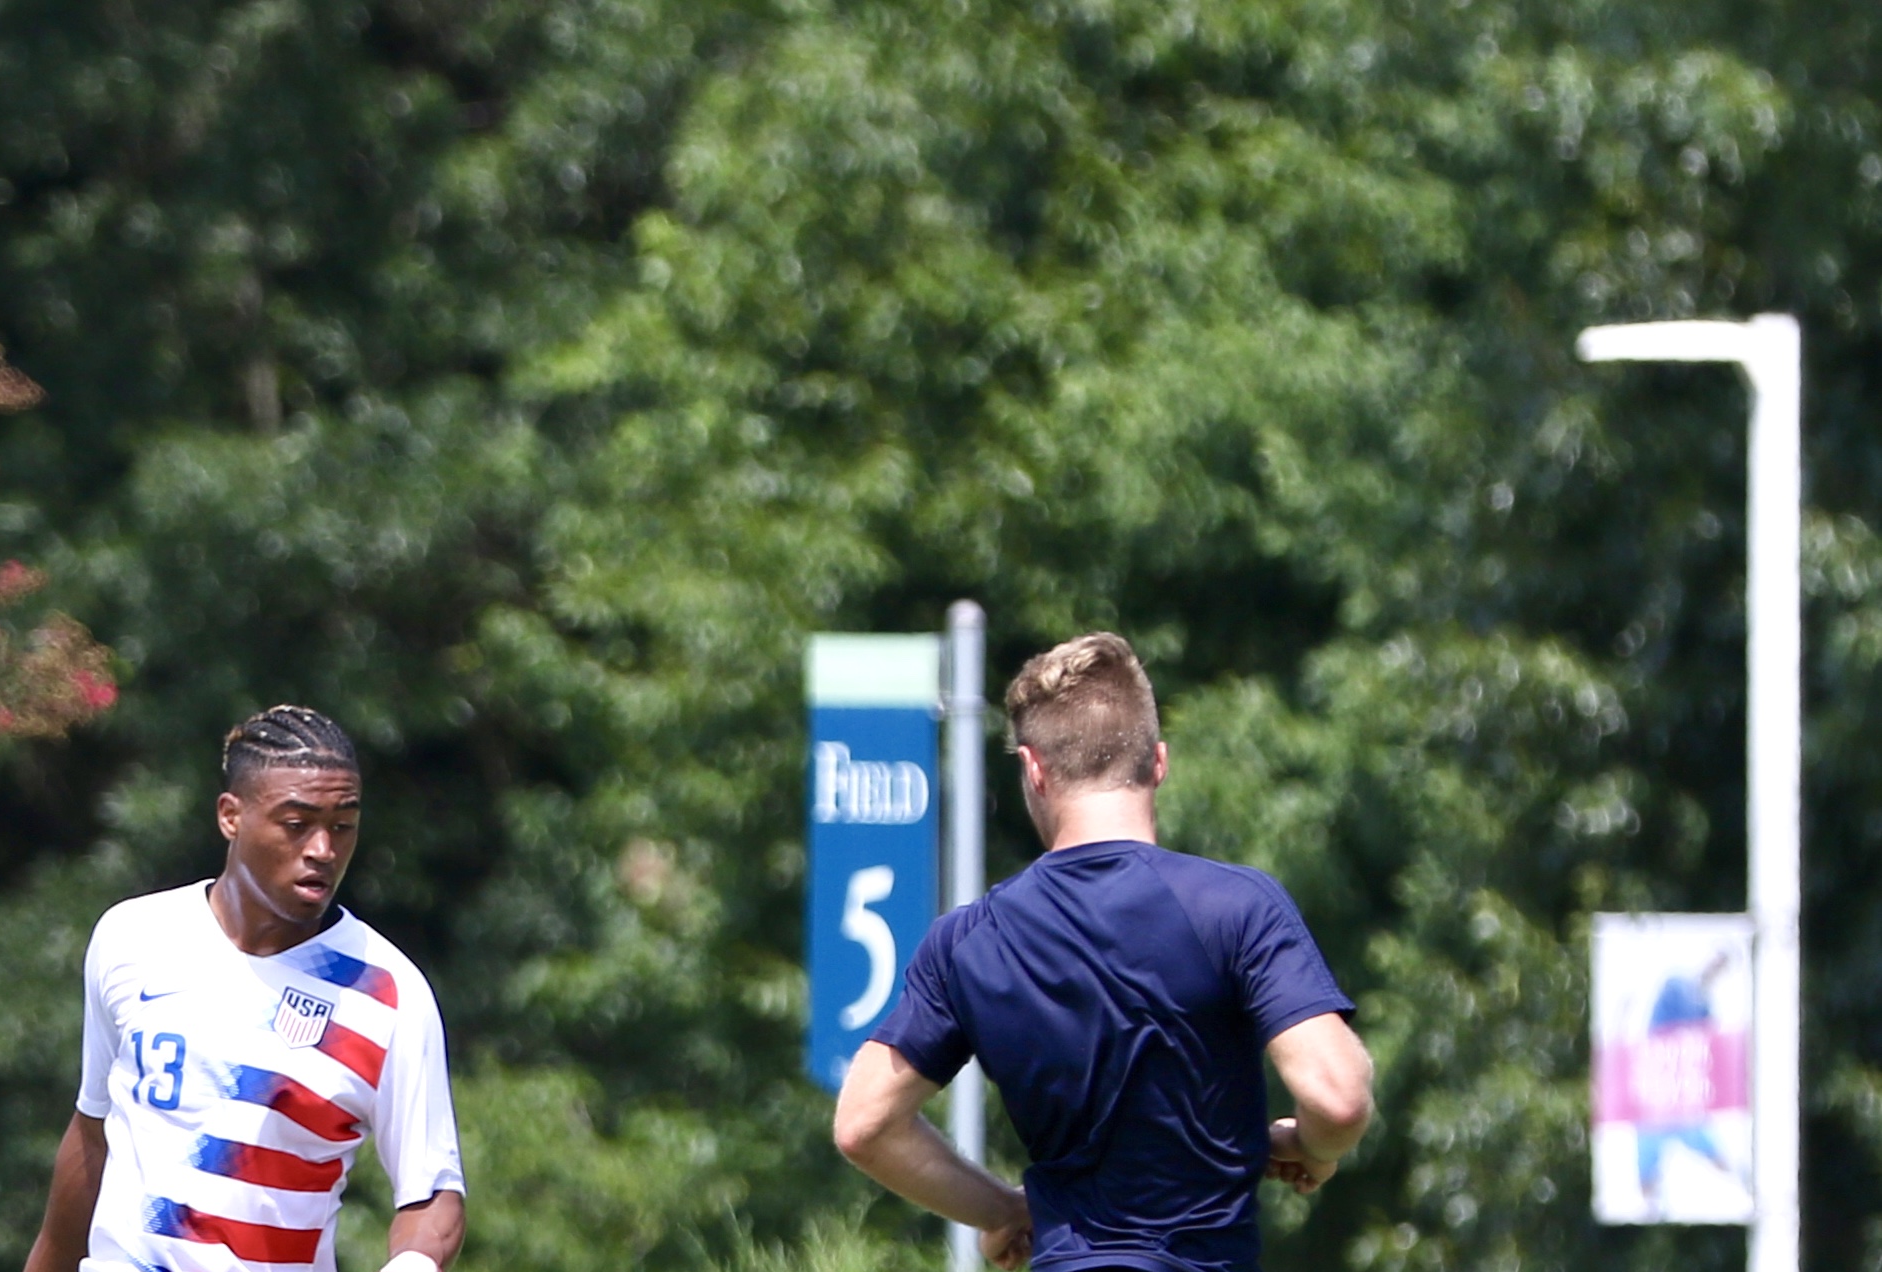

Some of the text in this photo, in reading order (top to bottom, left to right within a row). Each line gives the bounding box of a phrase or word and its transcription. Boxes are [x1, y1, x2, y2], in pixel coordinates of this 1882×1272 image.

[839, 864, 896, 1031] 5
[286, 992, 329, 1018] USA
[130, 1030, 187, 1112] 13
